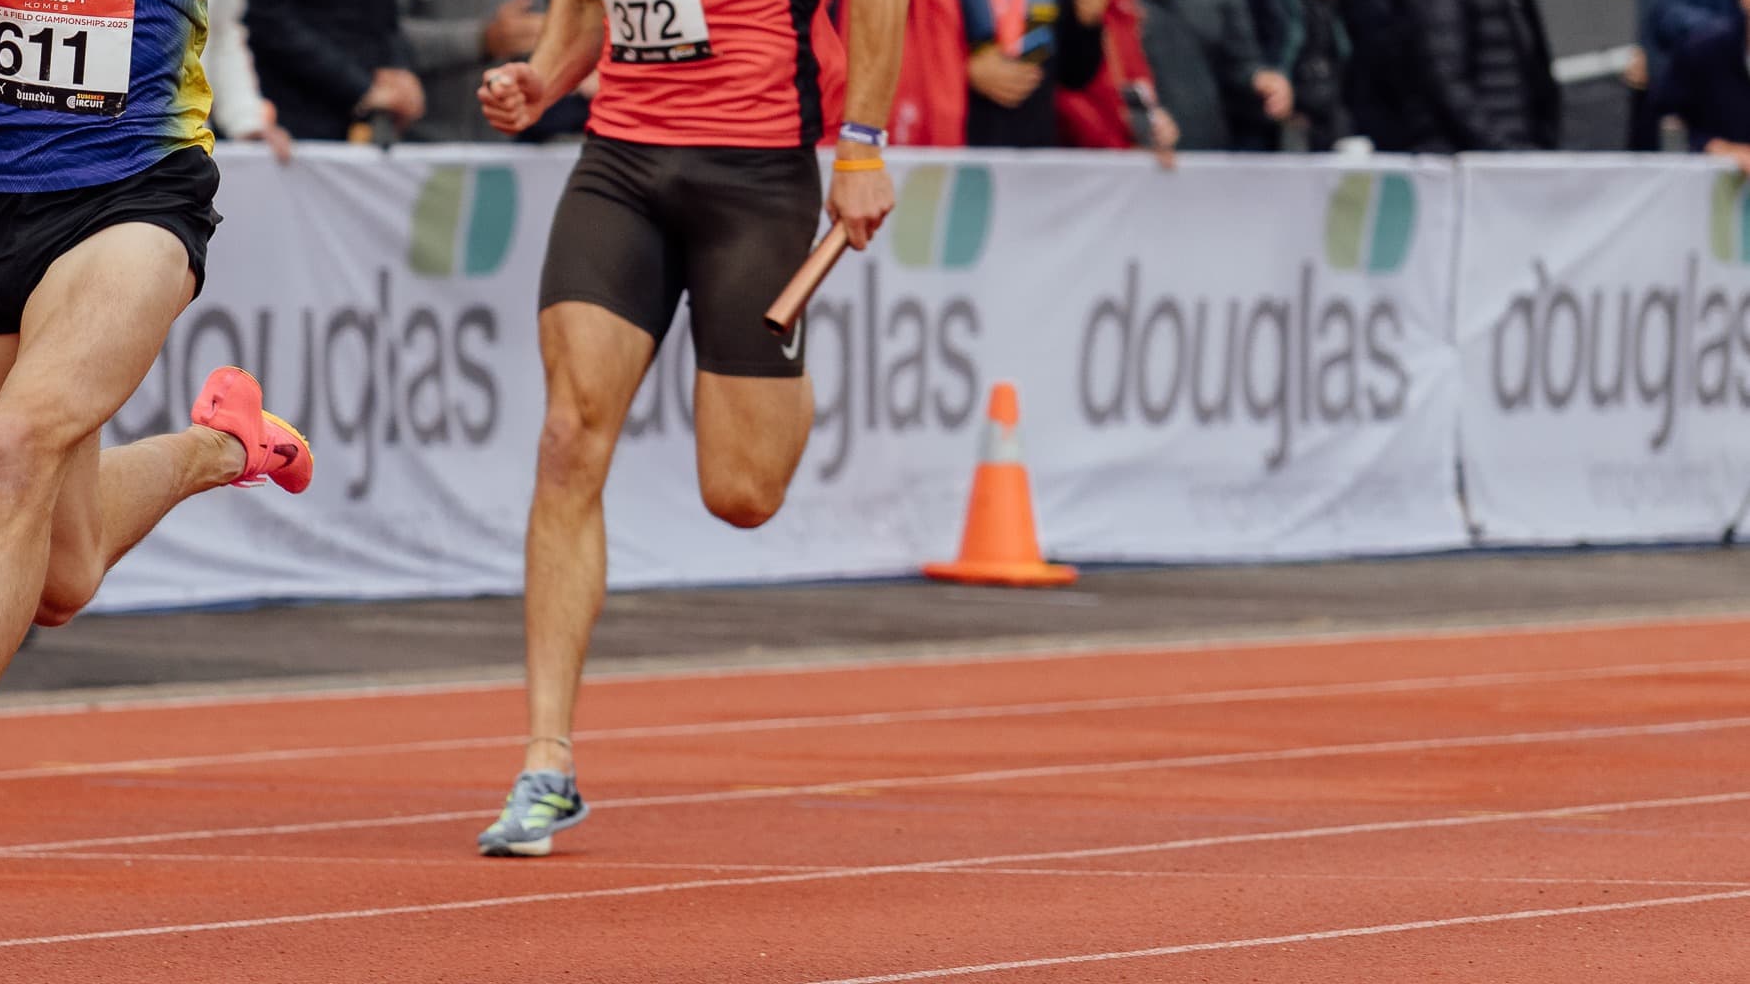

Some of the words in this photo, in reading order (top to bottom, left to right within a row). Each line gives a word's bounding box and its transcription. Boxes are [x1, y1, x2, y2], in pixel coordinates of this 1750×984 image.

[10, 11, 34, 22] FIELD
[35, 14, 106, 29] CHAMPIONSHIPS
[107, 20, 129, 30] 2025
[613, 0, 683, 42] 372
[1076, 258, 1412, 474] douglas
[1490, 248, 1750, 454] dougla
